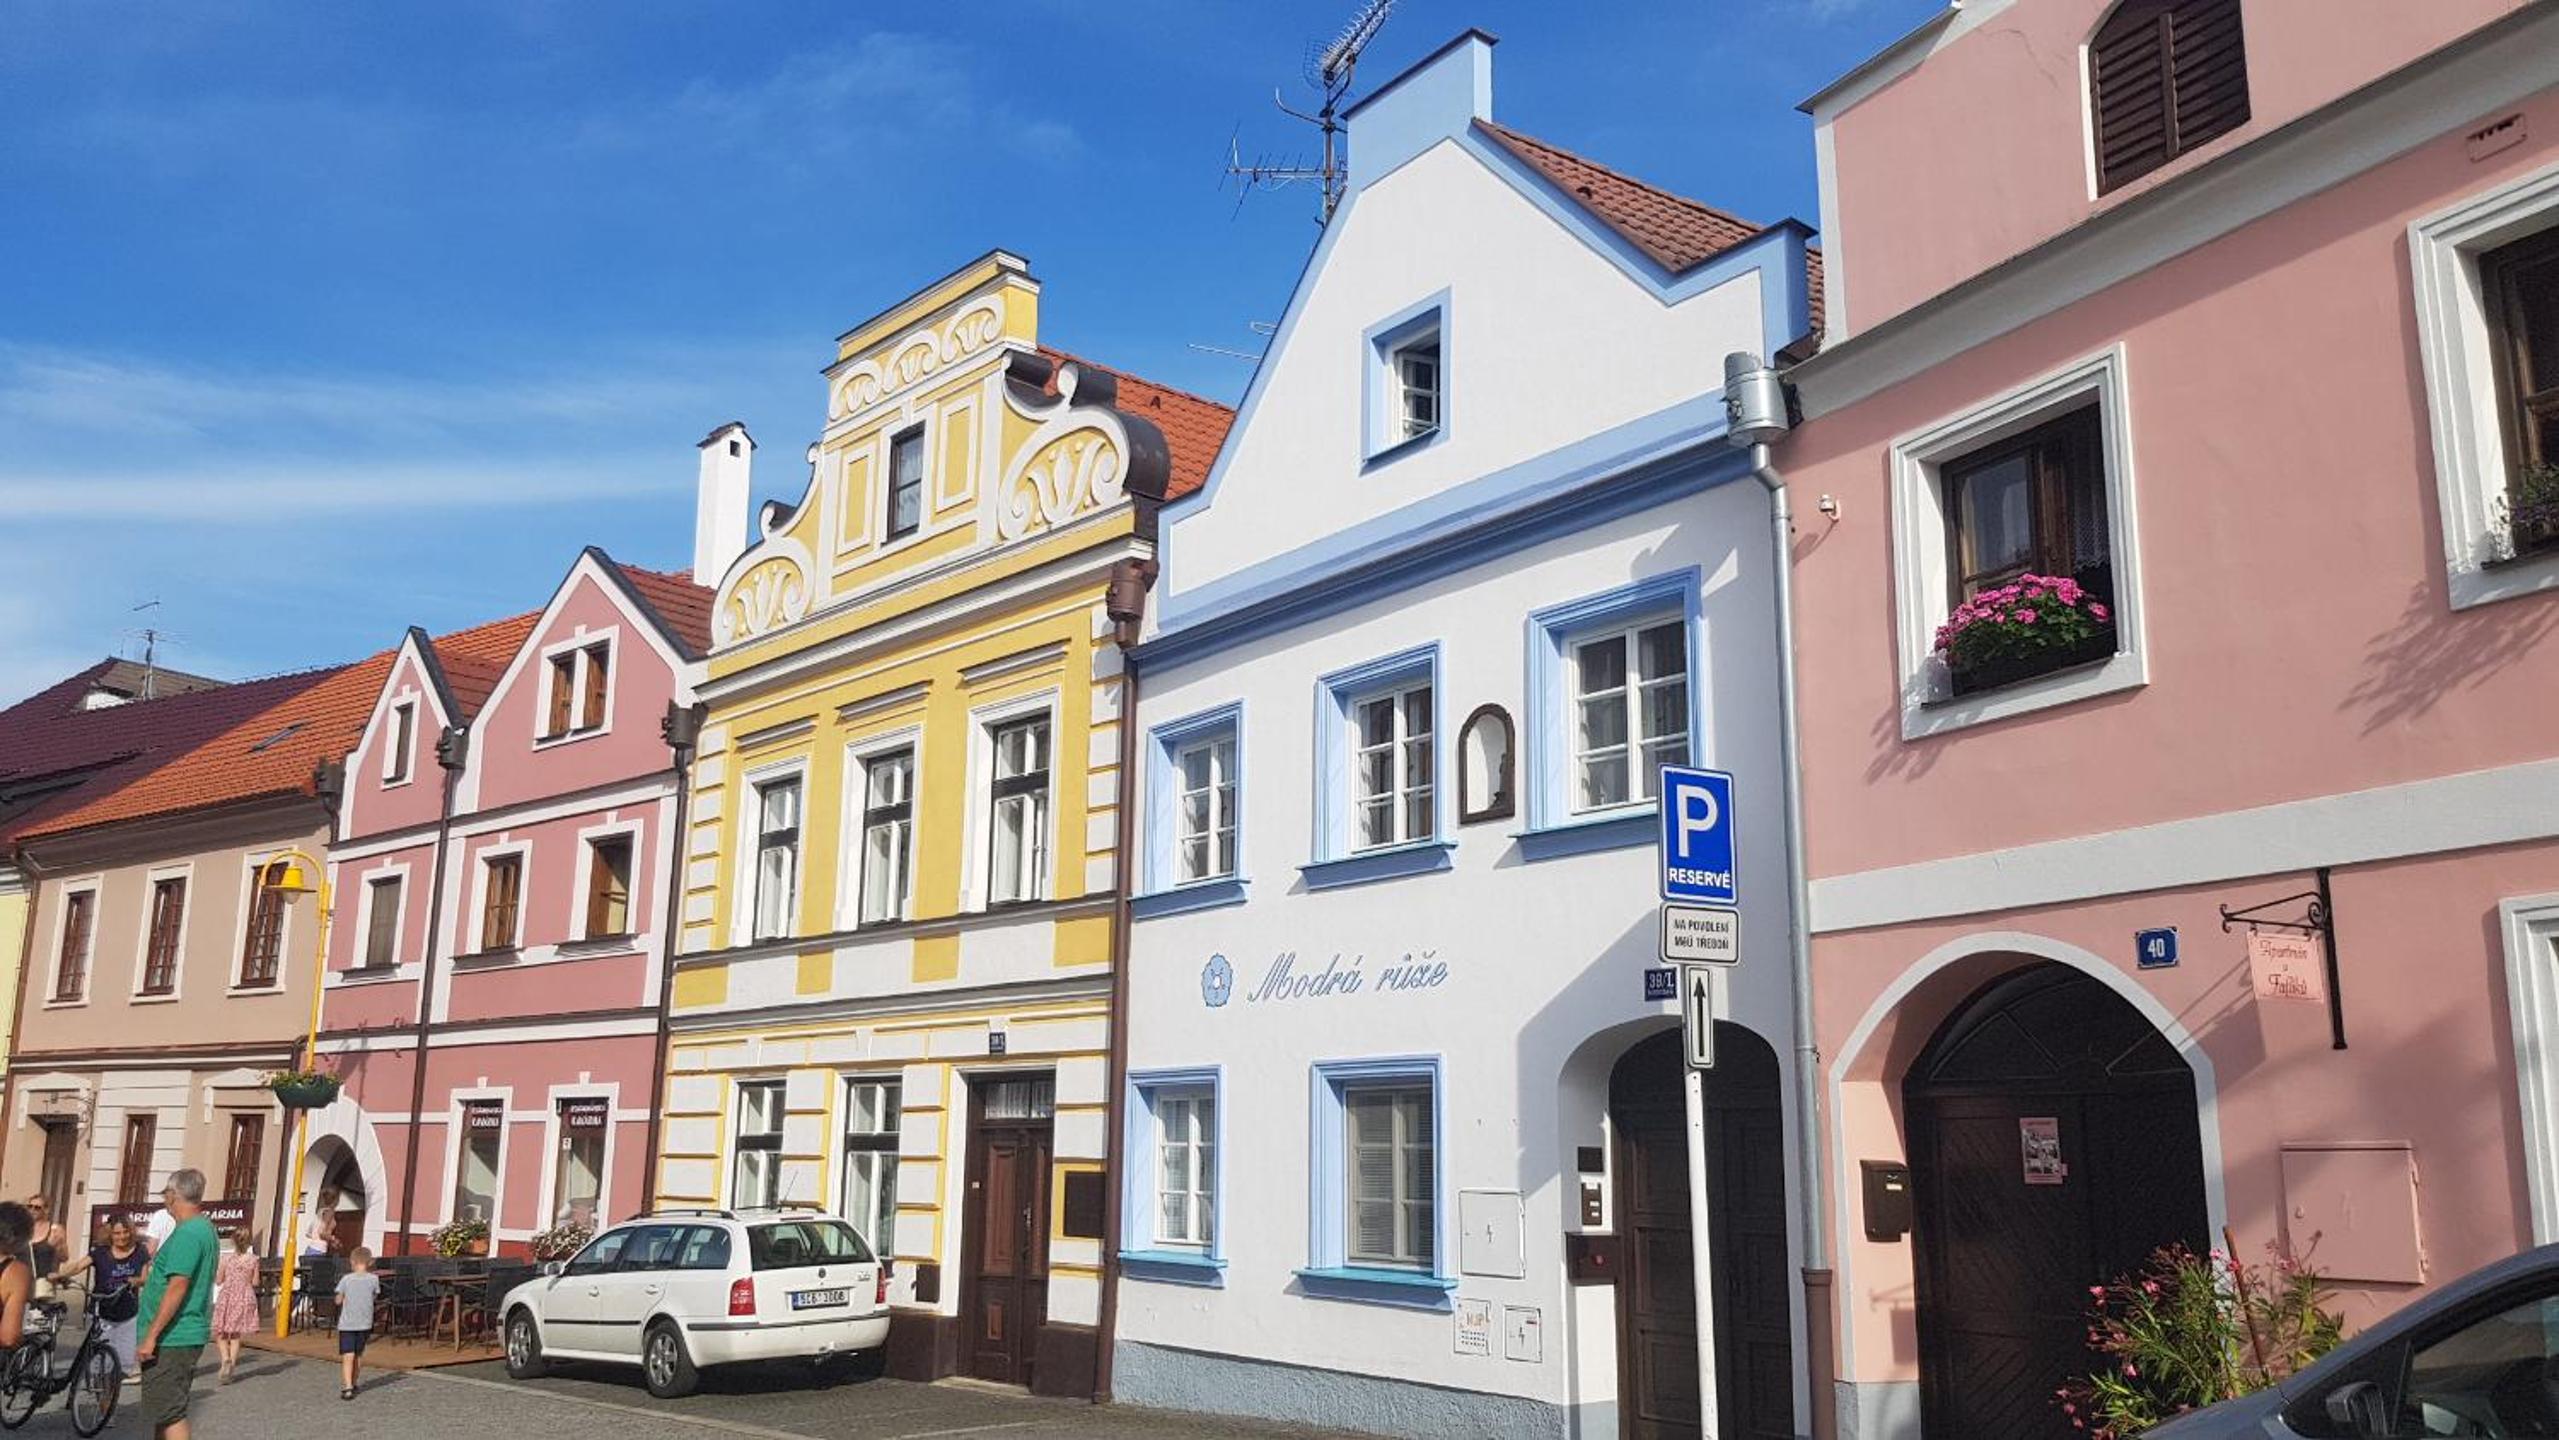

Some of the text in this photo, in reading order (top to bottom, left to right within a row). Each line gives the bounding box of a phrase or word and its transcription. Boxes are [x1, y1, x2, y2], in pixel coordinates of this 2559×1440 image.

[1676, 784, 1718, 857] P
[1668, 868, 1731, 889] RESERVÉ
[1674, 918, 1687, 931] NA
[2148, 938, 2165, 958] 40
[1246, 949, 1448, 1002] Modrá růže
